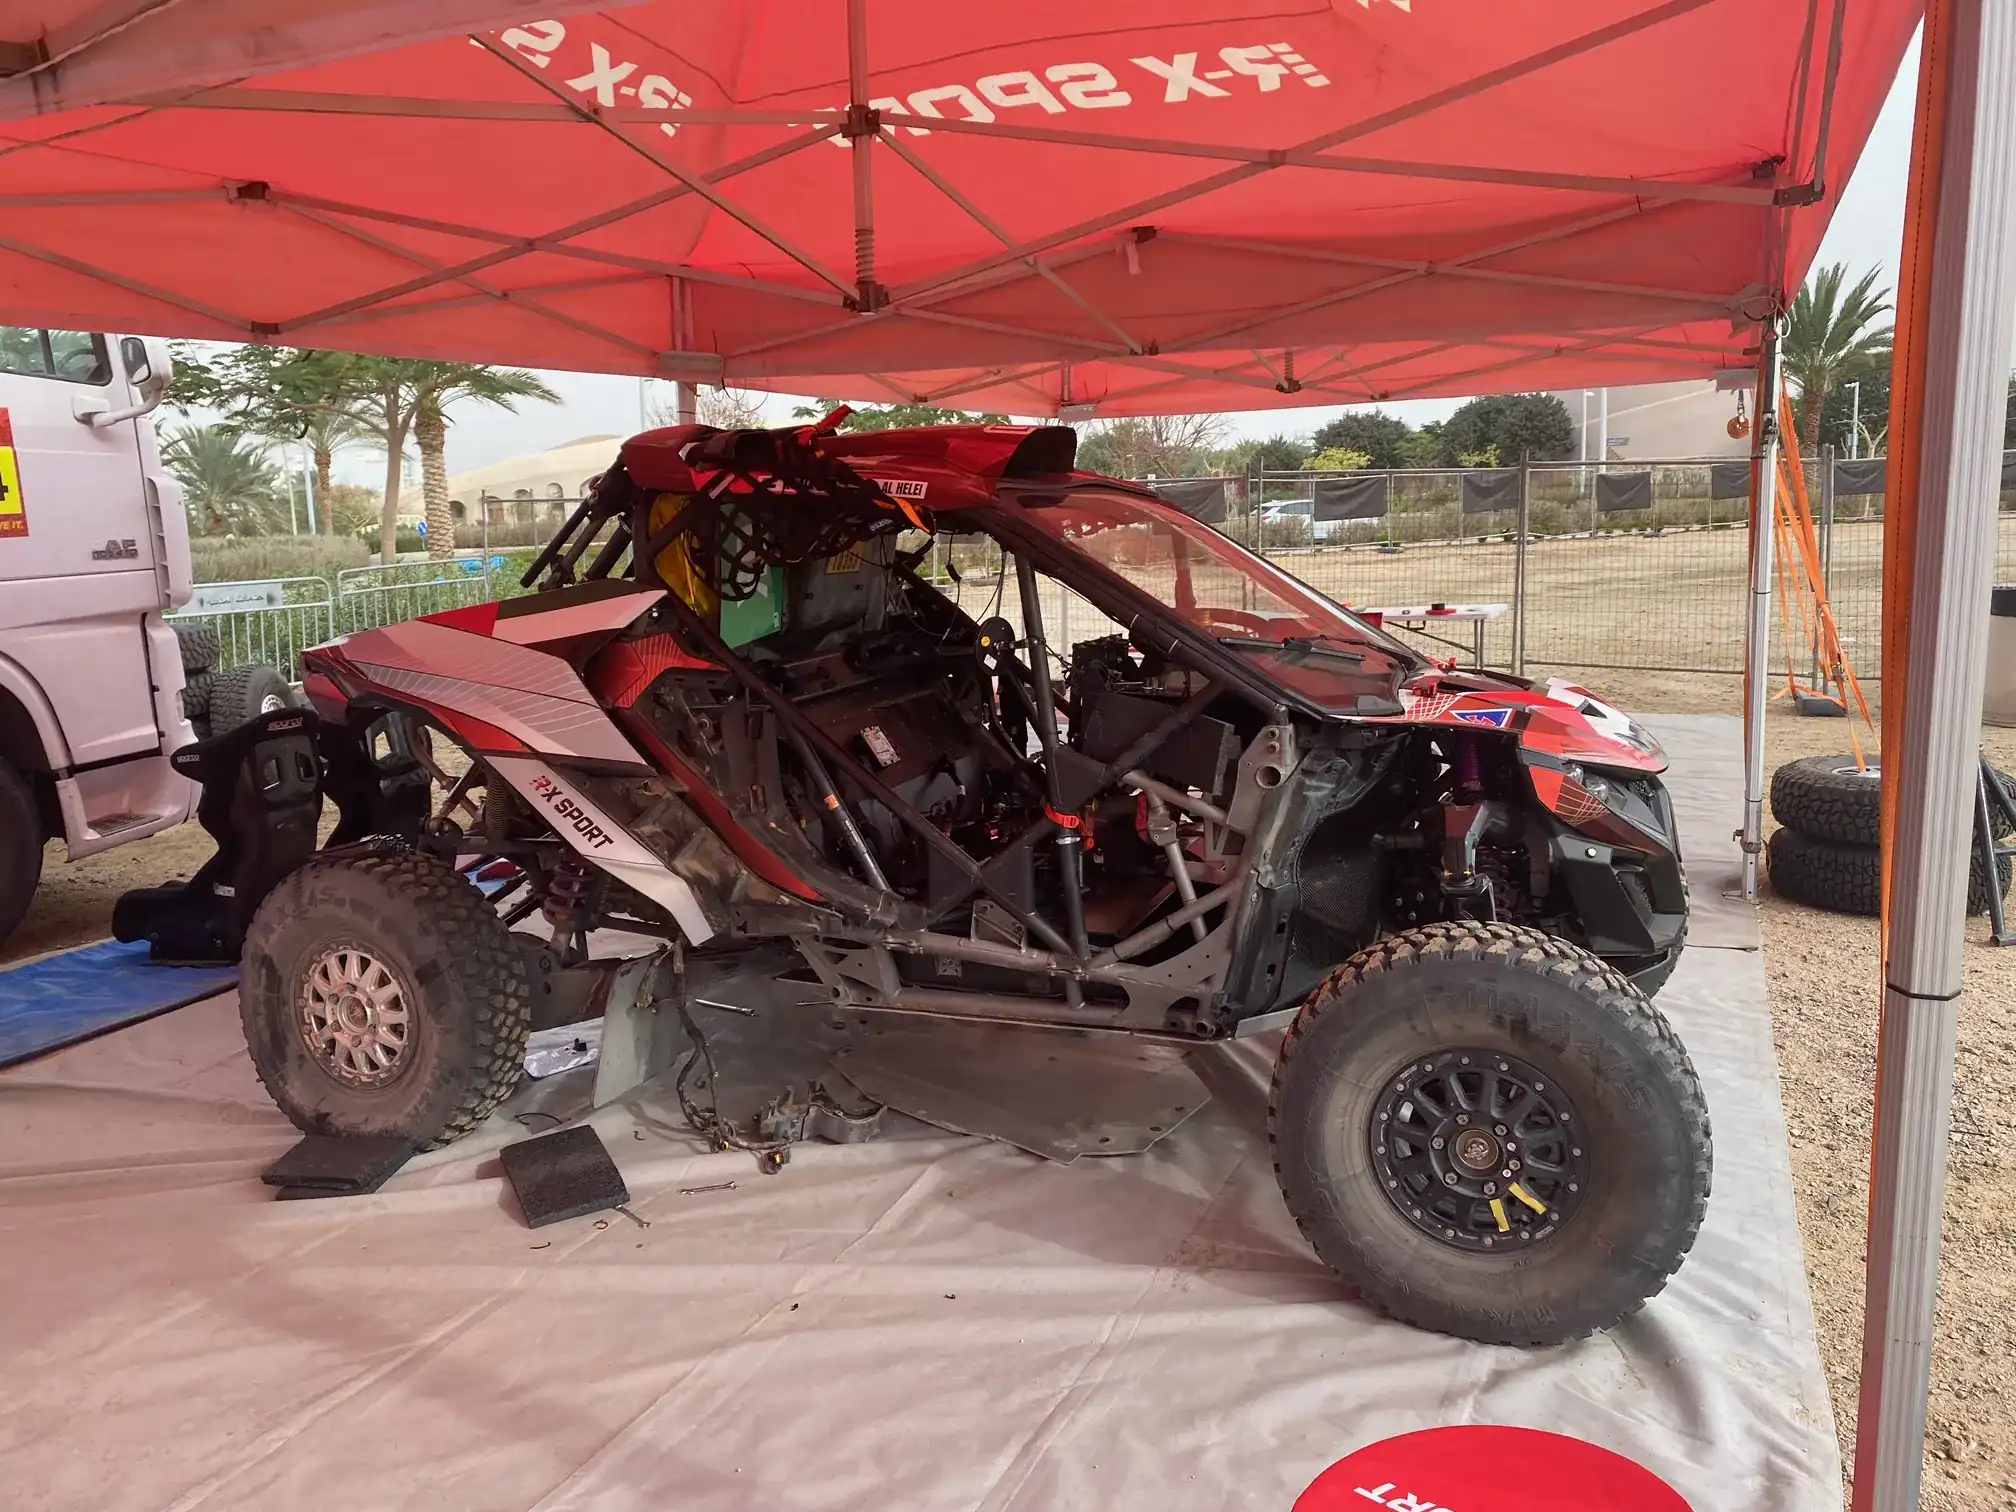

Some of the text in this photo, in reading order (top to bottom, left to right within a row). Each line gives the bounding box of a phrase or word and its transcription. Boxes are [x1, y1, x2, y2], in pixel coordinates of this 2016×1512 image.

[895, 482, 923, 496] HELEI
[554, 798, 614, 849] SPORT
[1353, 1483, 1454, 1512] RT
